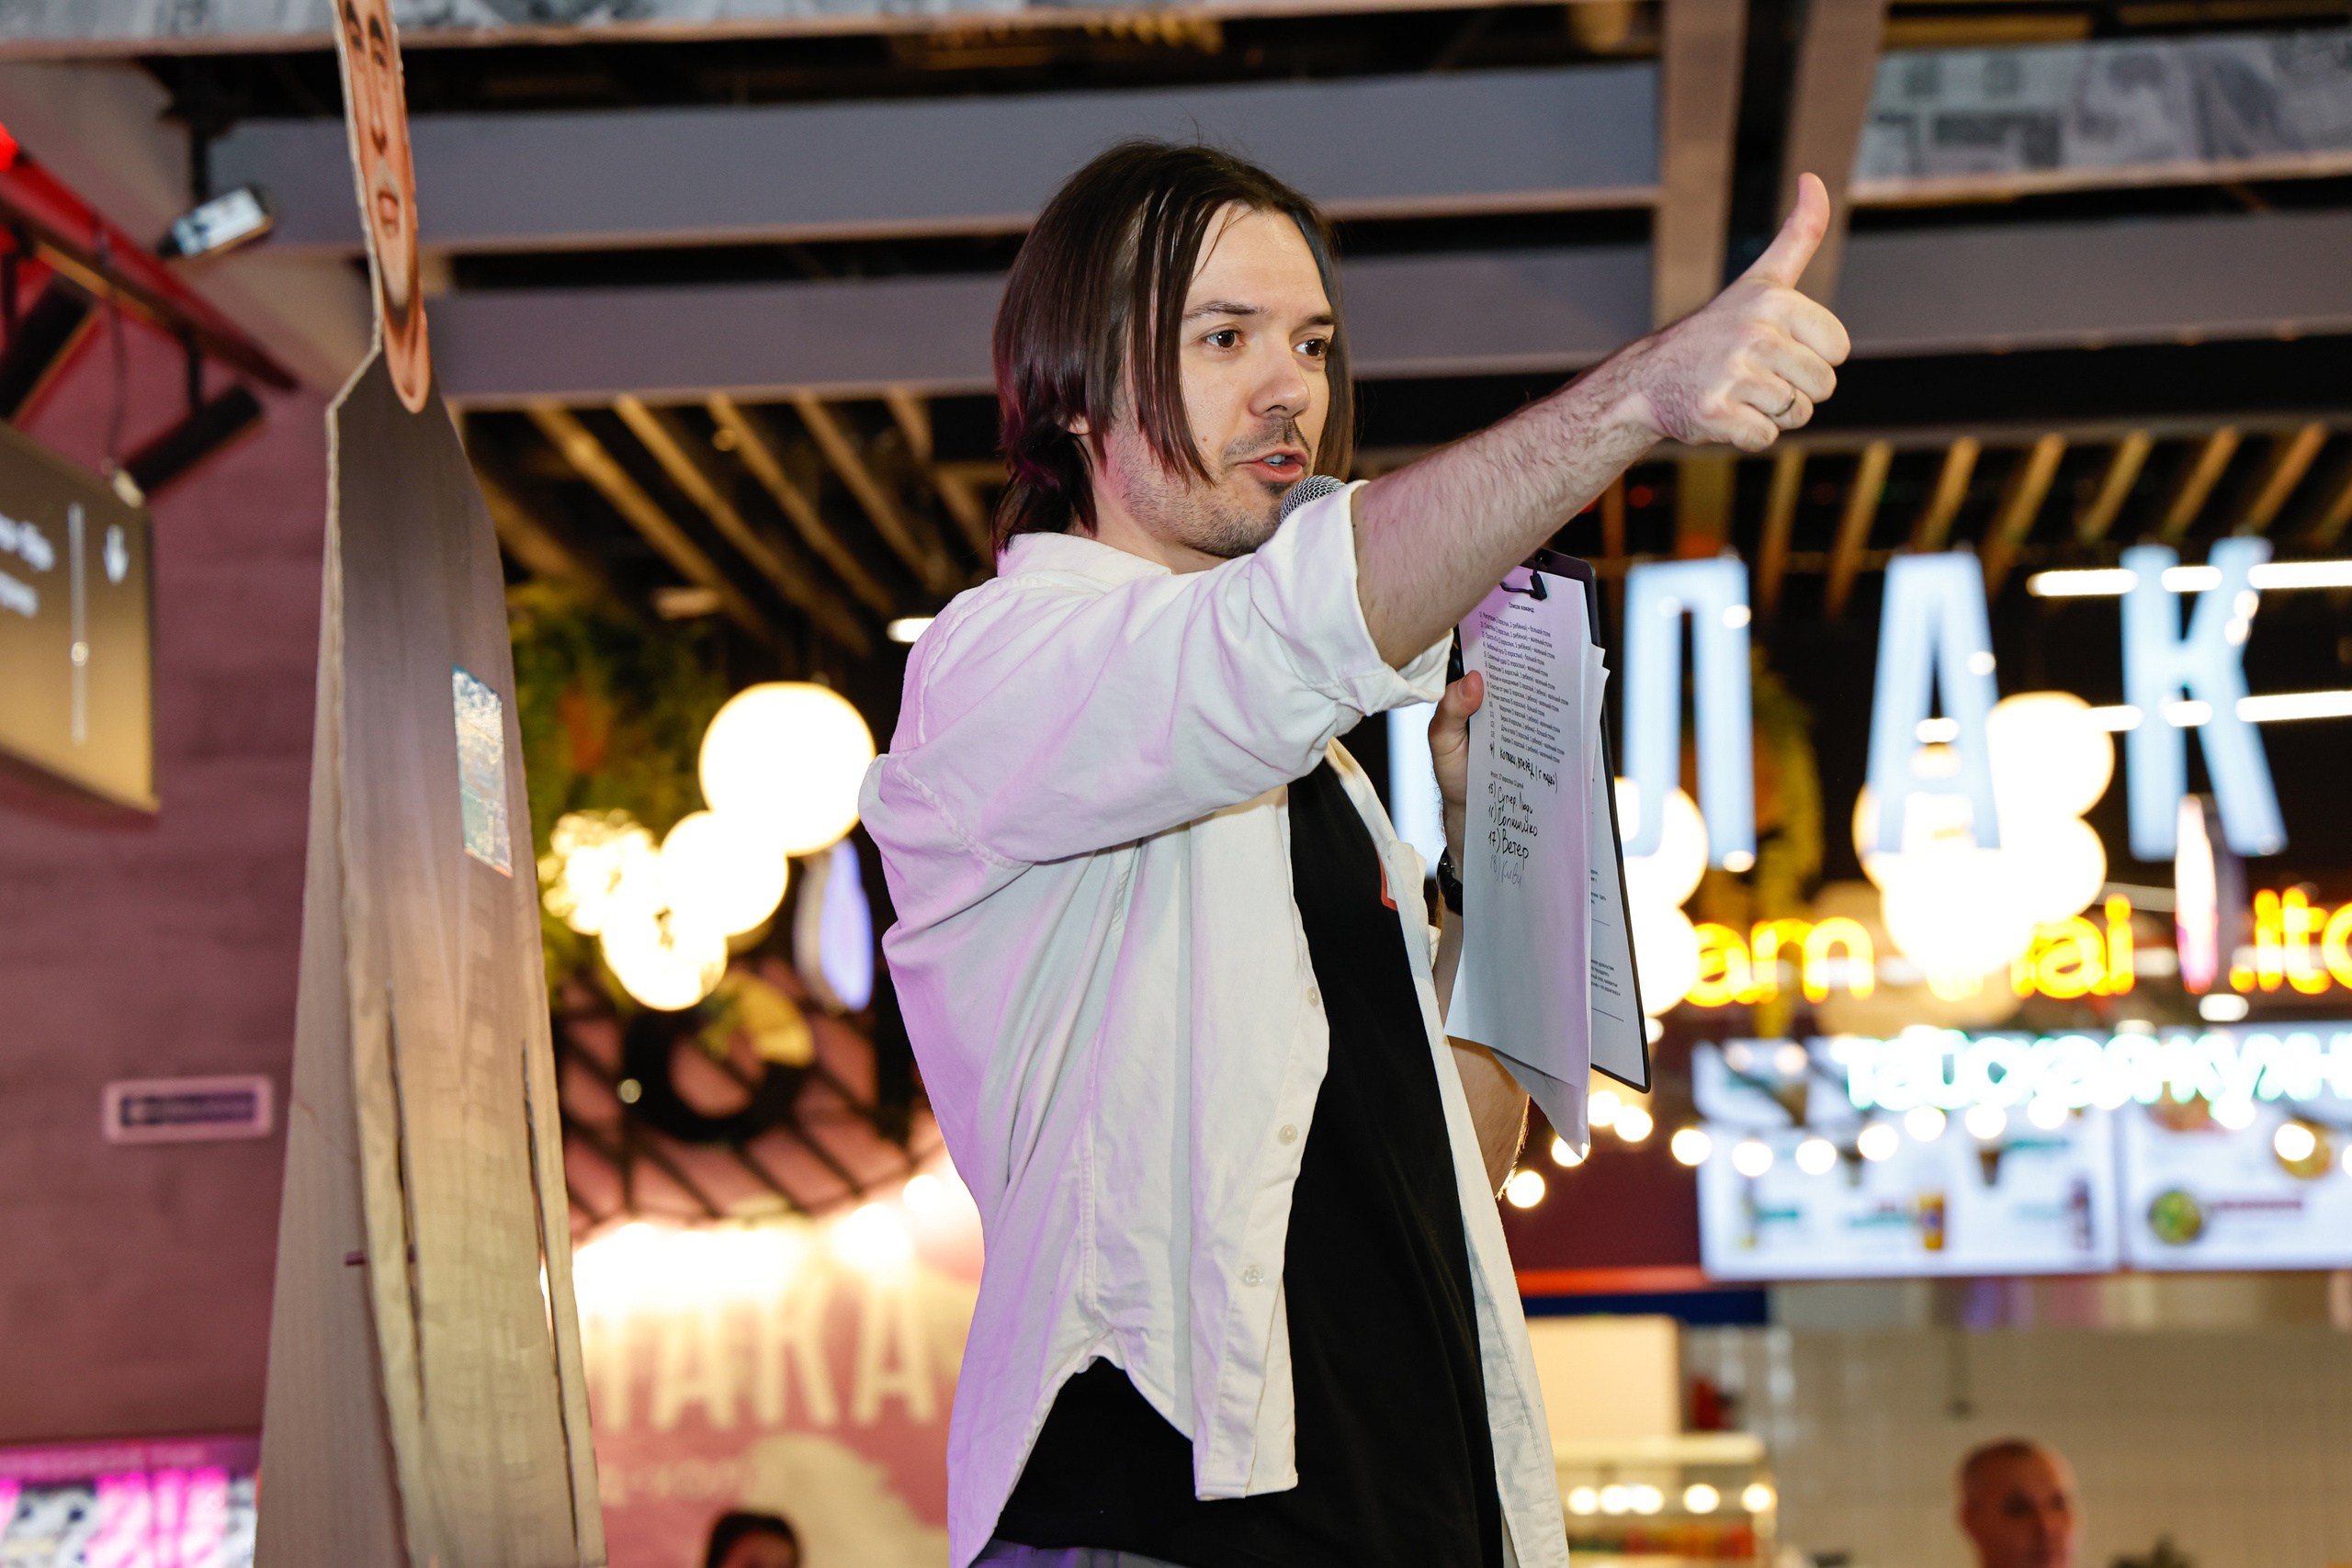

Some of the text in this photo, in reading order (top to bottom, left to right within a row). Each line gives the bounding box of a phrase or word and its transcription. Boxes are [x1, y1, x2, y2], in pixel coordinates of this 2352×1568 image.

[1385, 533, 2290, 878] ЛАК
[1488, 781, 1497, 797] 15)
[1488, 827, 1529, 871] 17) Ветер
